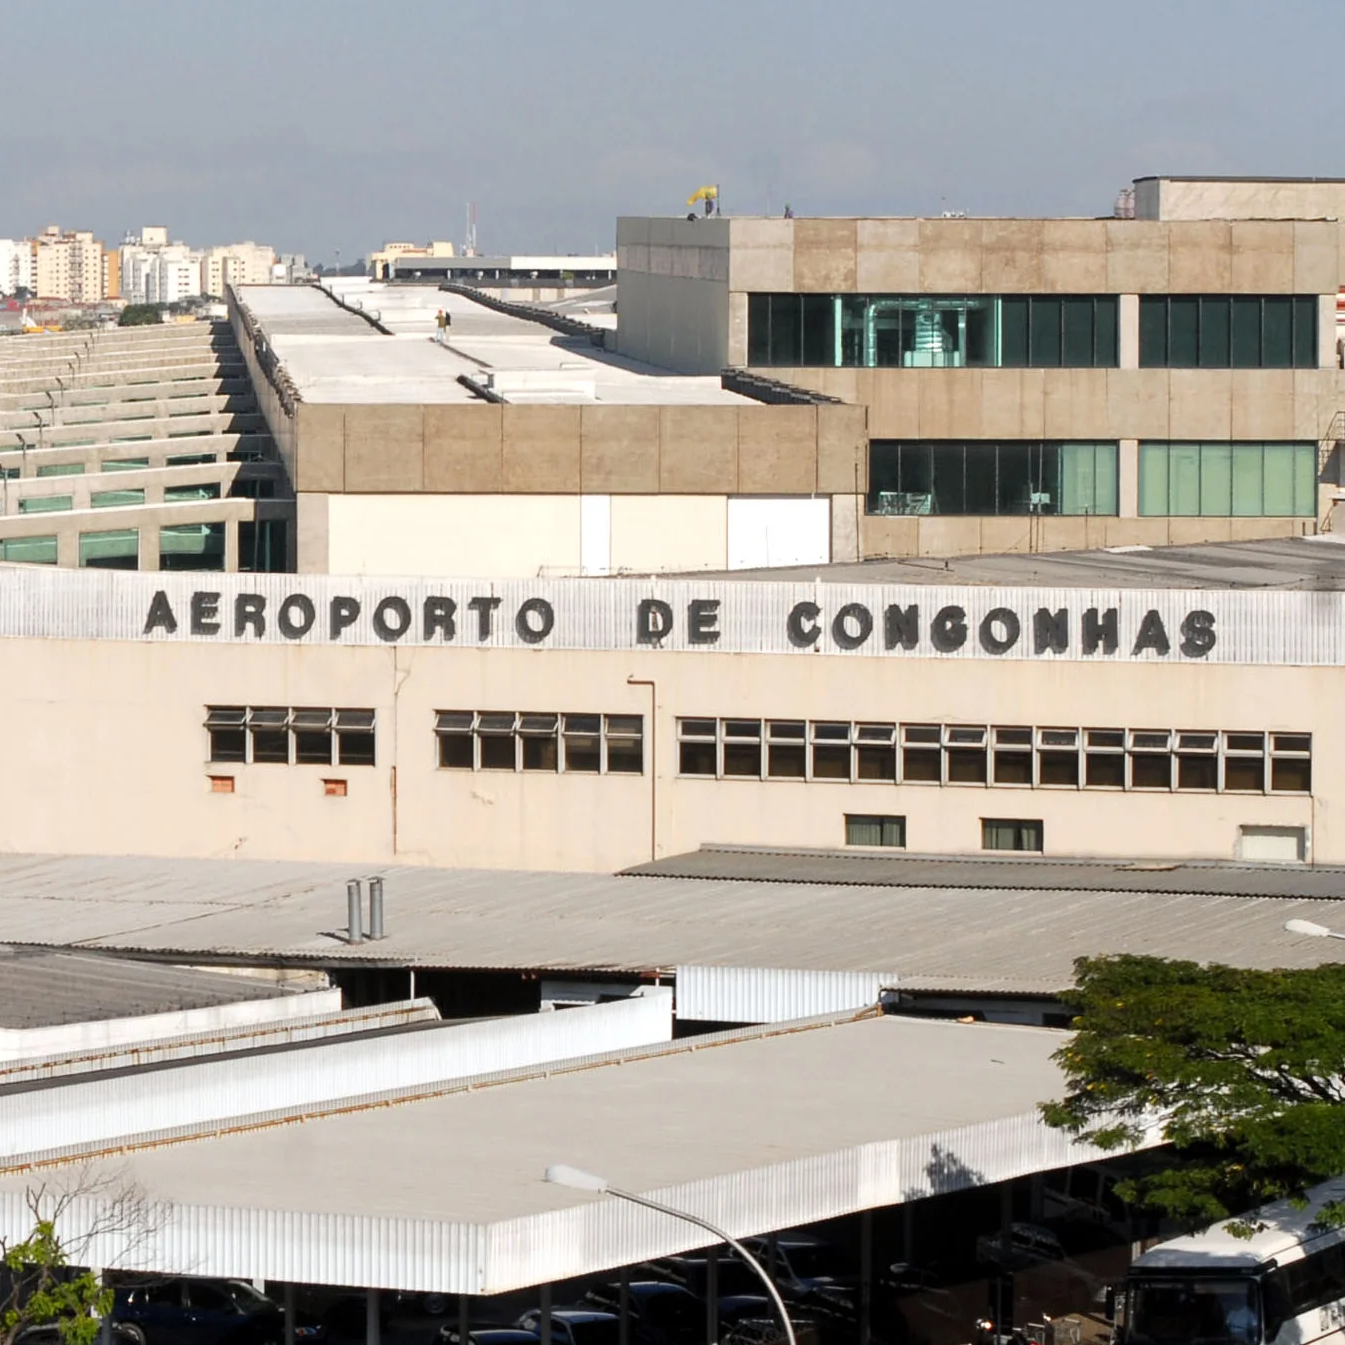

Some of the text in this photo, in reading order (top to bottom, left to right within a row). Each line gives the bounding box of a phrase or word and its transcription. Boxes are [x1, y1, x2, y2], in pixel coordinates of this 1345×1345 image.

[143, 590, 1217, 658] AEROPORTO DE CONGONHAS
